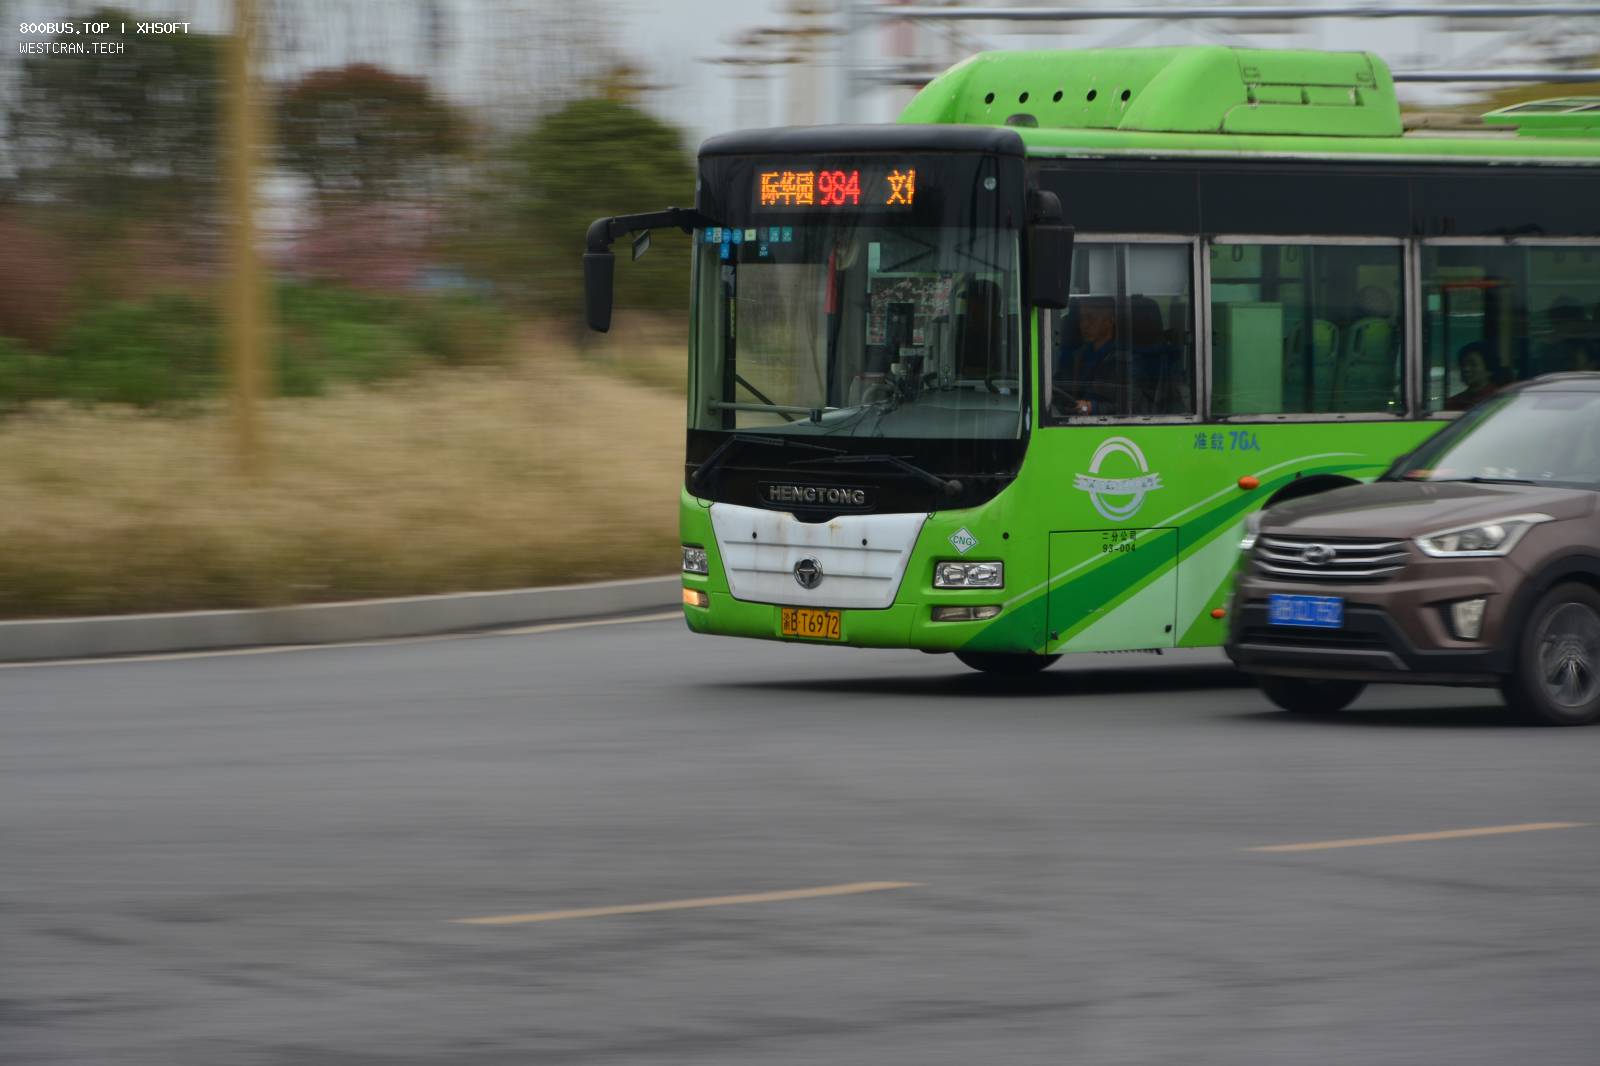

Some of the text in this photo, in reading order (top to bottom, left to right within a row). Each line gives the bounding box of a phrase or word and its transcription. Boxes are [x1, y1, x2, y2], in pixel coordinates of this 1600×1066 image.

[818, 169, 861, 206] 984
[769, 485, 865, 505] HENGTONG
[953, 535, 972, 546] CNG
